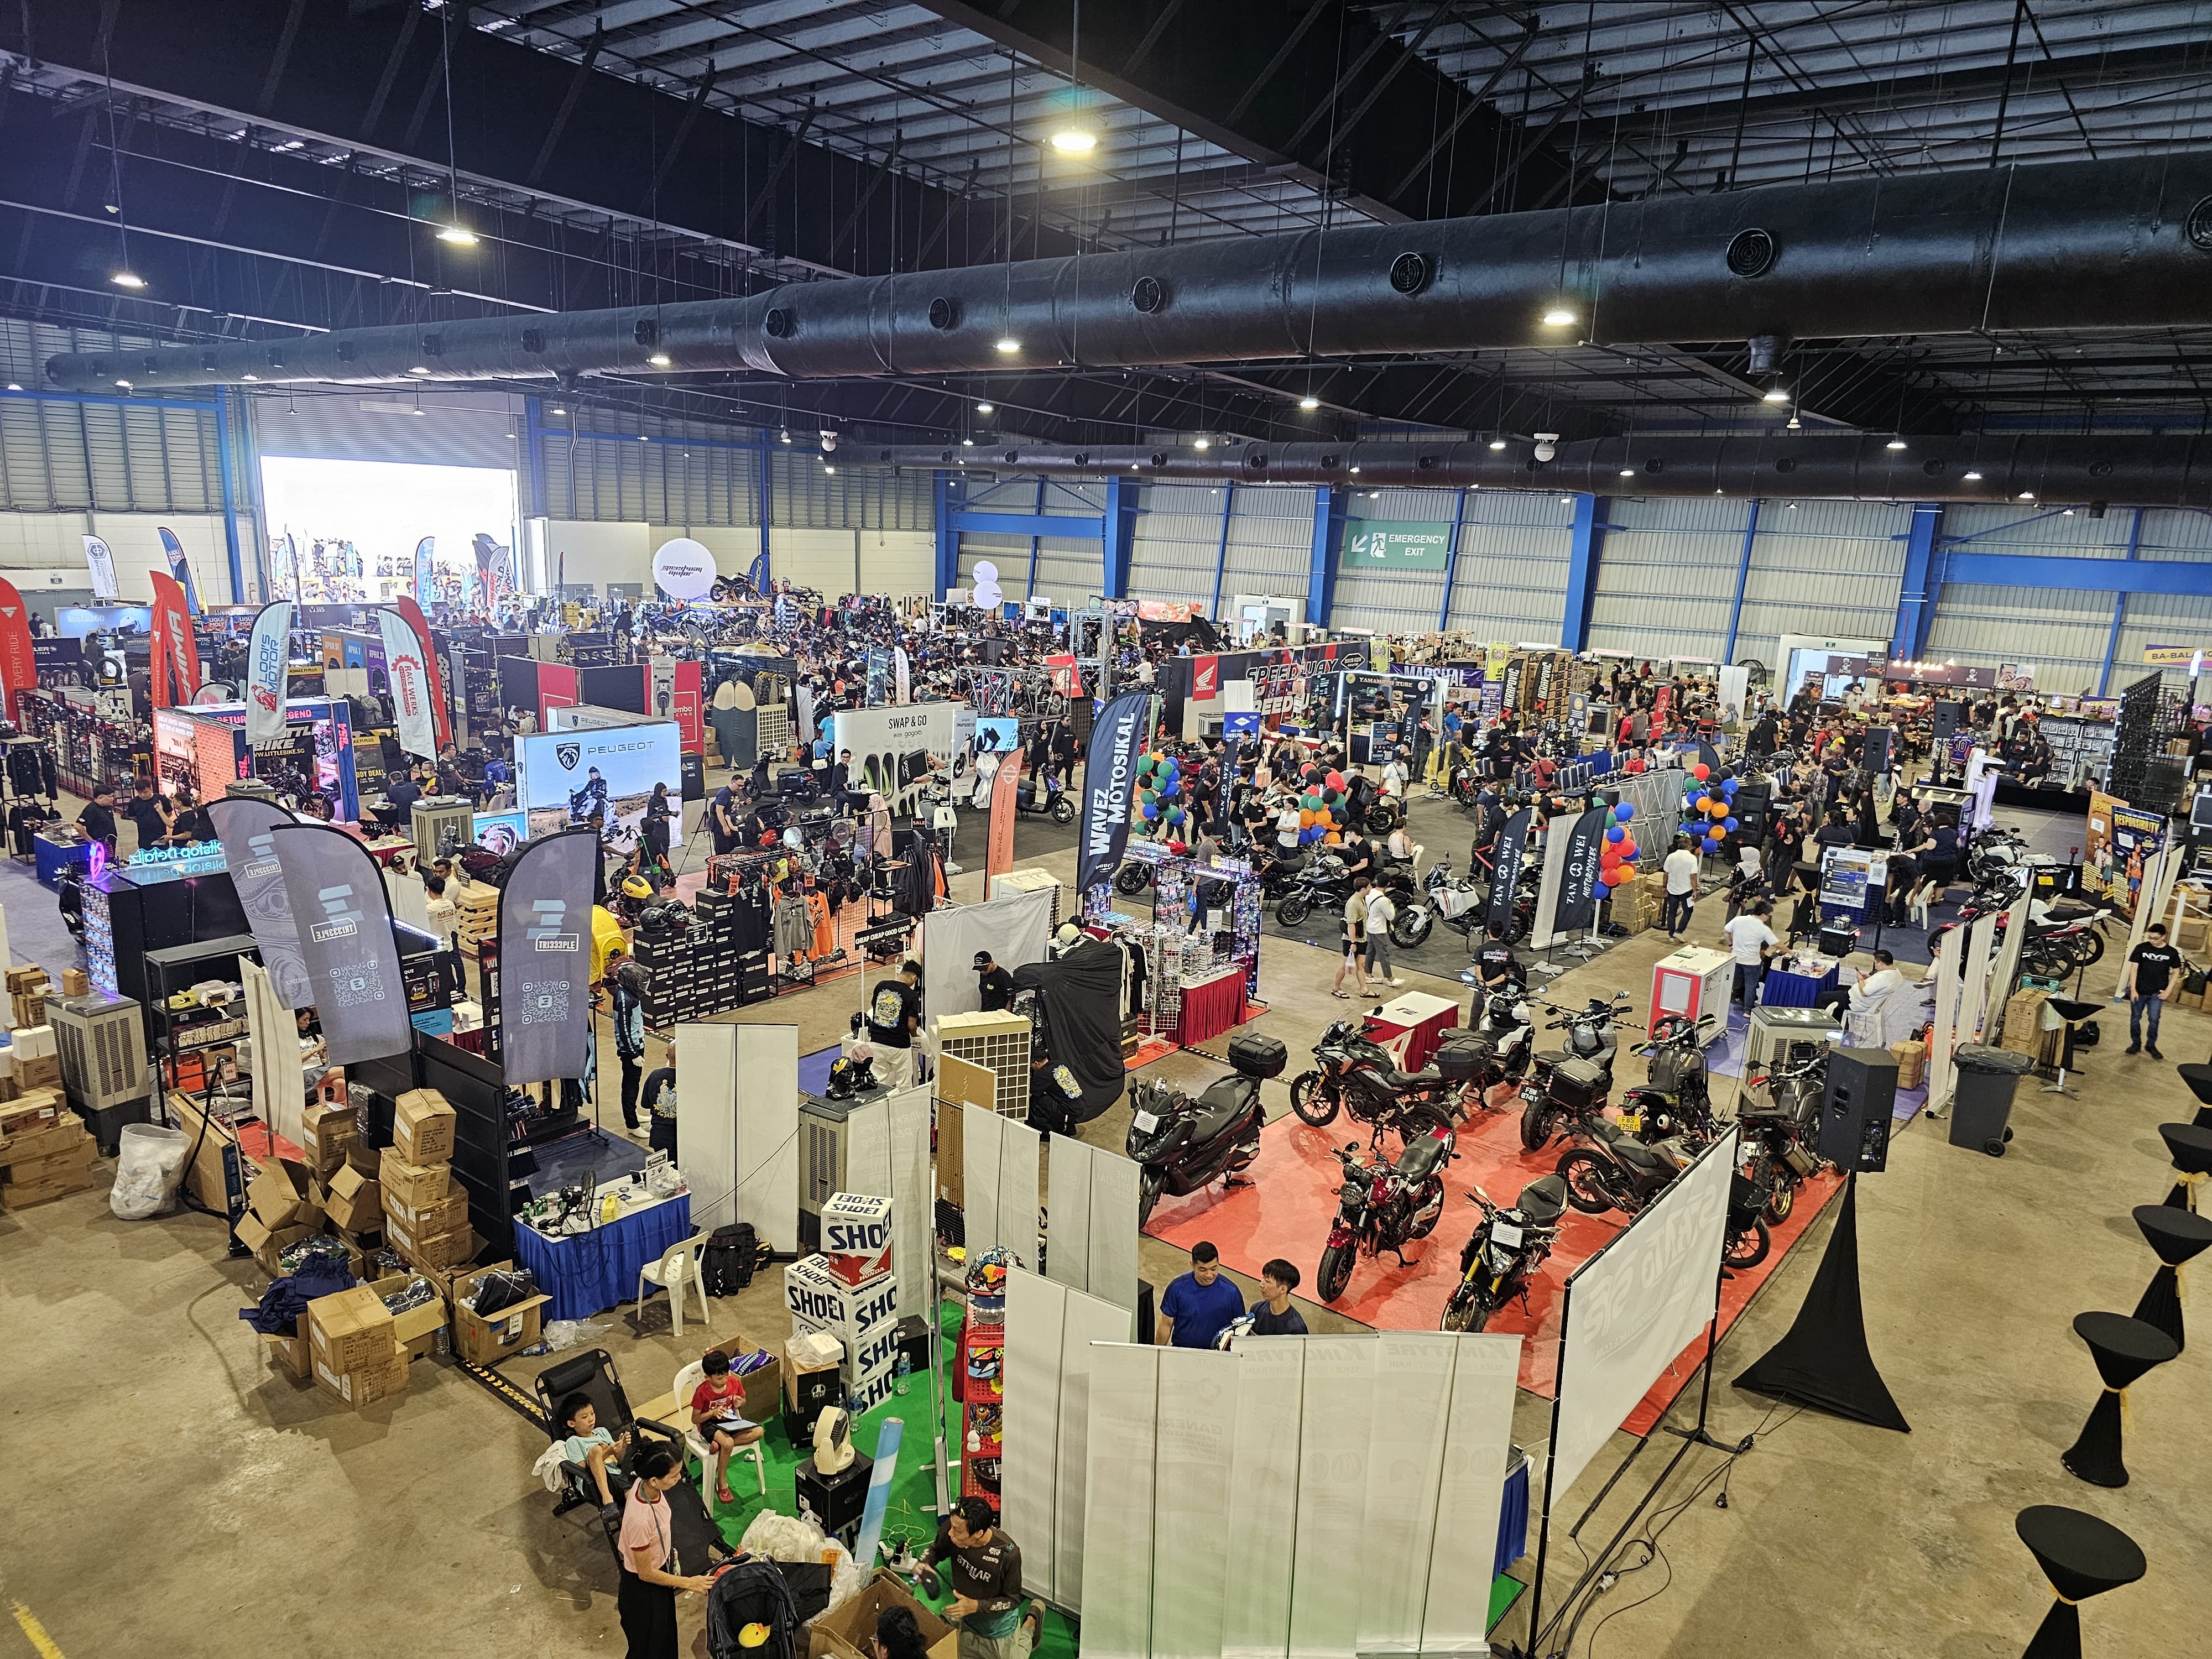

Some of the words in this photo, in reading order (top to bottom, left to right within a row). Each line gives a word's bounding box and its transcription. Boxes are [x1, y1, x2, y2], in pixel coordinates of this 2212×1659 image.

[1389, 534, 1445, 544] EMERGENCY
[1405, 548, 1425, 556] EXIT
[67, 615, 105, 624] Insta360
[8, 631, 20, 653] RIDE
[167, 608, 192, 705] SHIMA
[258, 634, 270, 683] LOOI'S
[268, 639, 279, 693] MOTOR
[12, 656, 23, 686] EVERY
[404, 666, 414, 686] RACE
[1404, 665, 1467, 688] MARSHAL
[1359, 677, 1393, 686] YAMAMOTO
[408, 688, 419, 716] WERKS
[217, 716, 246, 724] RETUR
[285, 709, 312, 719] EGEND
[581, 717, 609, 727] PEUGEOT
[889, 716, 910, 729] SWAP
[911, 716, 916, 727] &
[917, 715, 927, 726] GO
[254, 738, 295, 752] BIKE
[254, 748, 305, 757] W.LITTLEBIKE.SG
[588, 742, 655, 755] PEUGEOT
[1107, 712, 1135, 824] MOTOSIKAL
[1088, 788, 1110, 857] WAVEZ
[2114, 813, 2159, 837] RESPONSIBILITY
[1493, 884, 1504, 906] TAN
[1501, 836, 1513, 859] WEI
[1566, 881, 1578, 904] TAN
[1574, 834, 1586, 857] WEI
[1582, 846, 1598, 898] MOTORCYCLES
[855, 935, 870, 945] CHEAP
[870, 932, 884, 941] CHEAP
[884, 928, 898, 938] GOOD
[898, 924, 910, 935] GOOD
[2142, 952, 2170, 961] NYP
[830, 1203, 880, 1215] SHOEI
[837, 1194, 885, 1205] SHOEI
[830, 1267, 851, 1283] HONDA
[859, 1266, 885, 1281] HONDA
[788, 1285, 845, 1322] SHOEI
[956, 1555, 992, 1581] STELLAR
